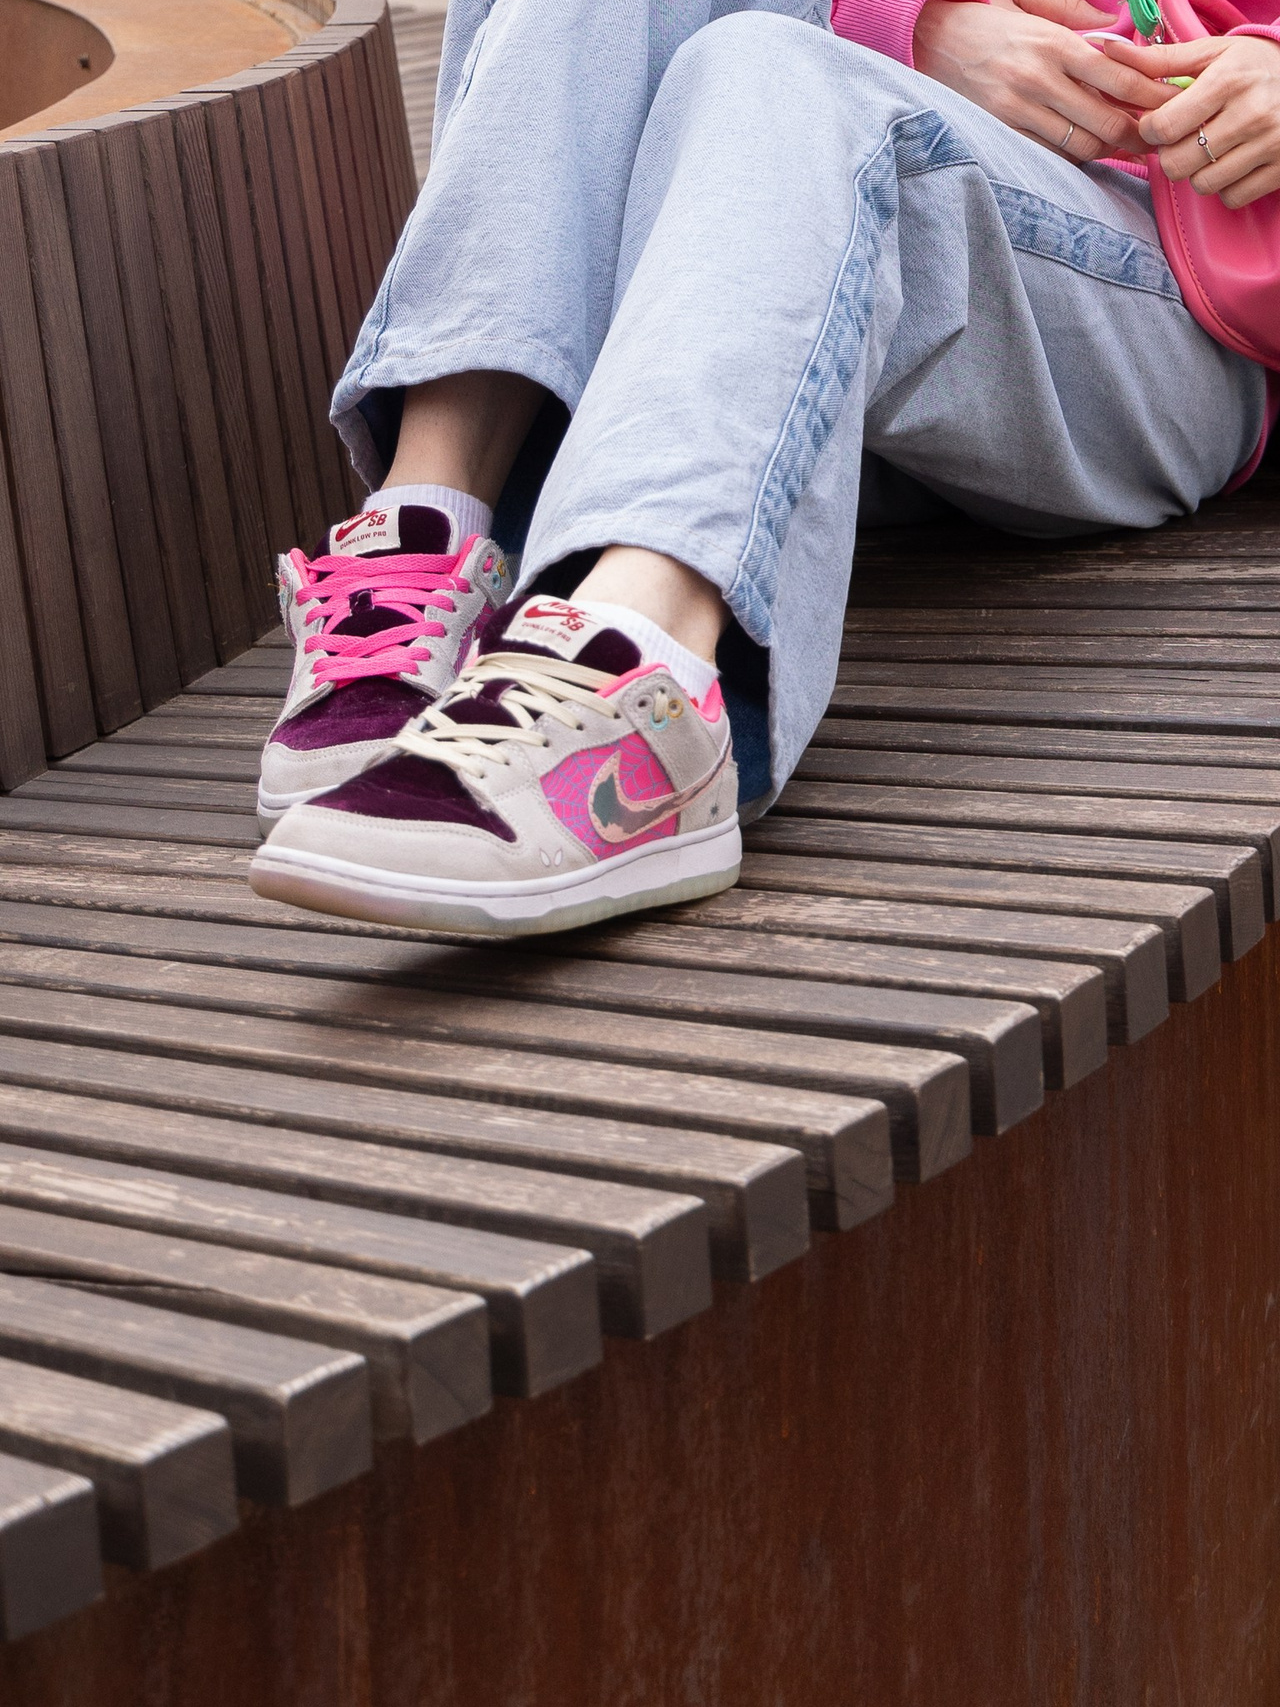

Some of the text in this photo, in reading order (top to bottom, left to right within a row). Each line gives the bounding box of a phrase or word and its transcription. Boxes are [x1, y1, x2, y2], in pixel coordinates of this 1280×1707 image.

[367, 513, 387, 527] SB
[356, 532, 371, 541] LOW
[560, 617, 584, 631] SB
